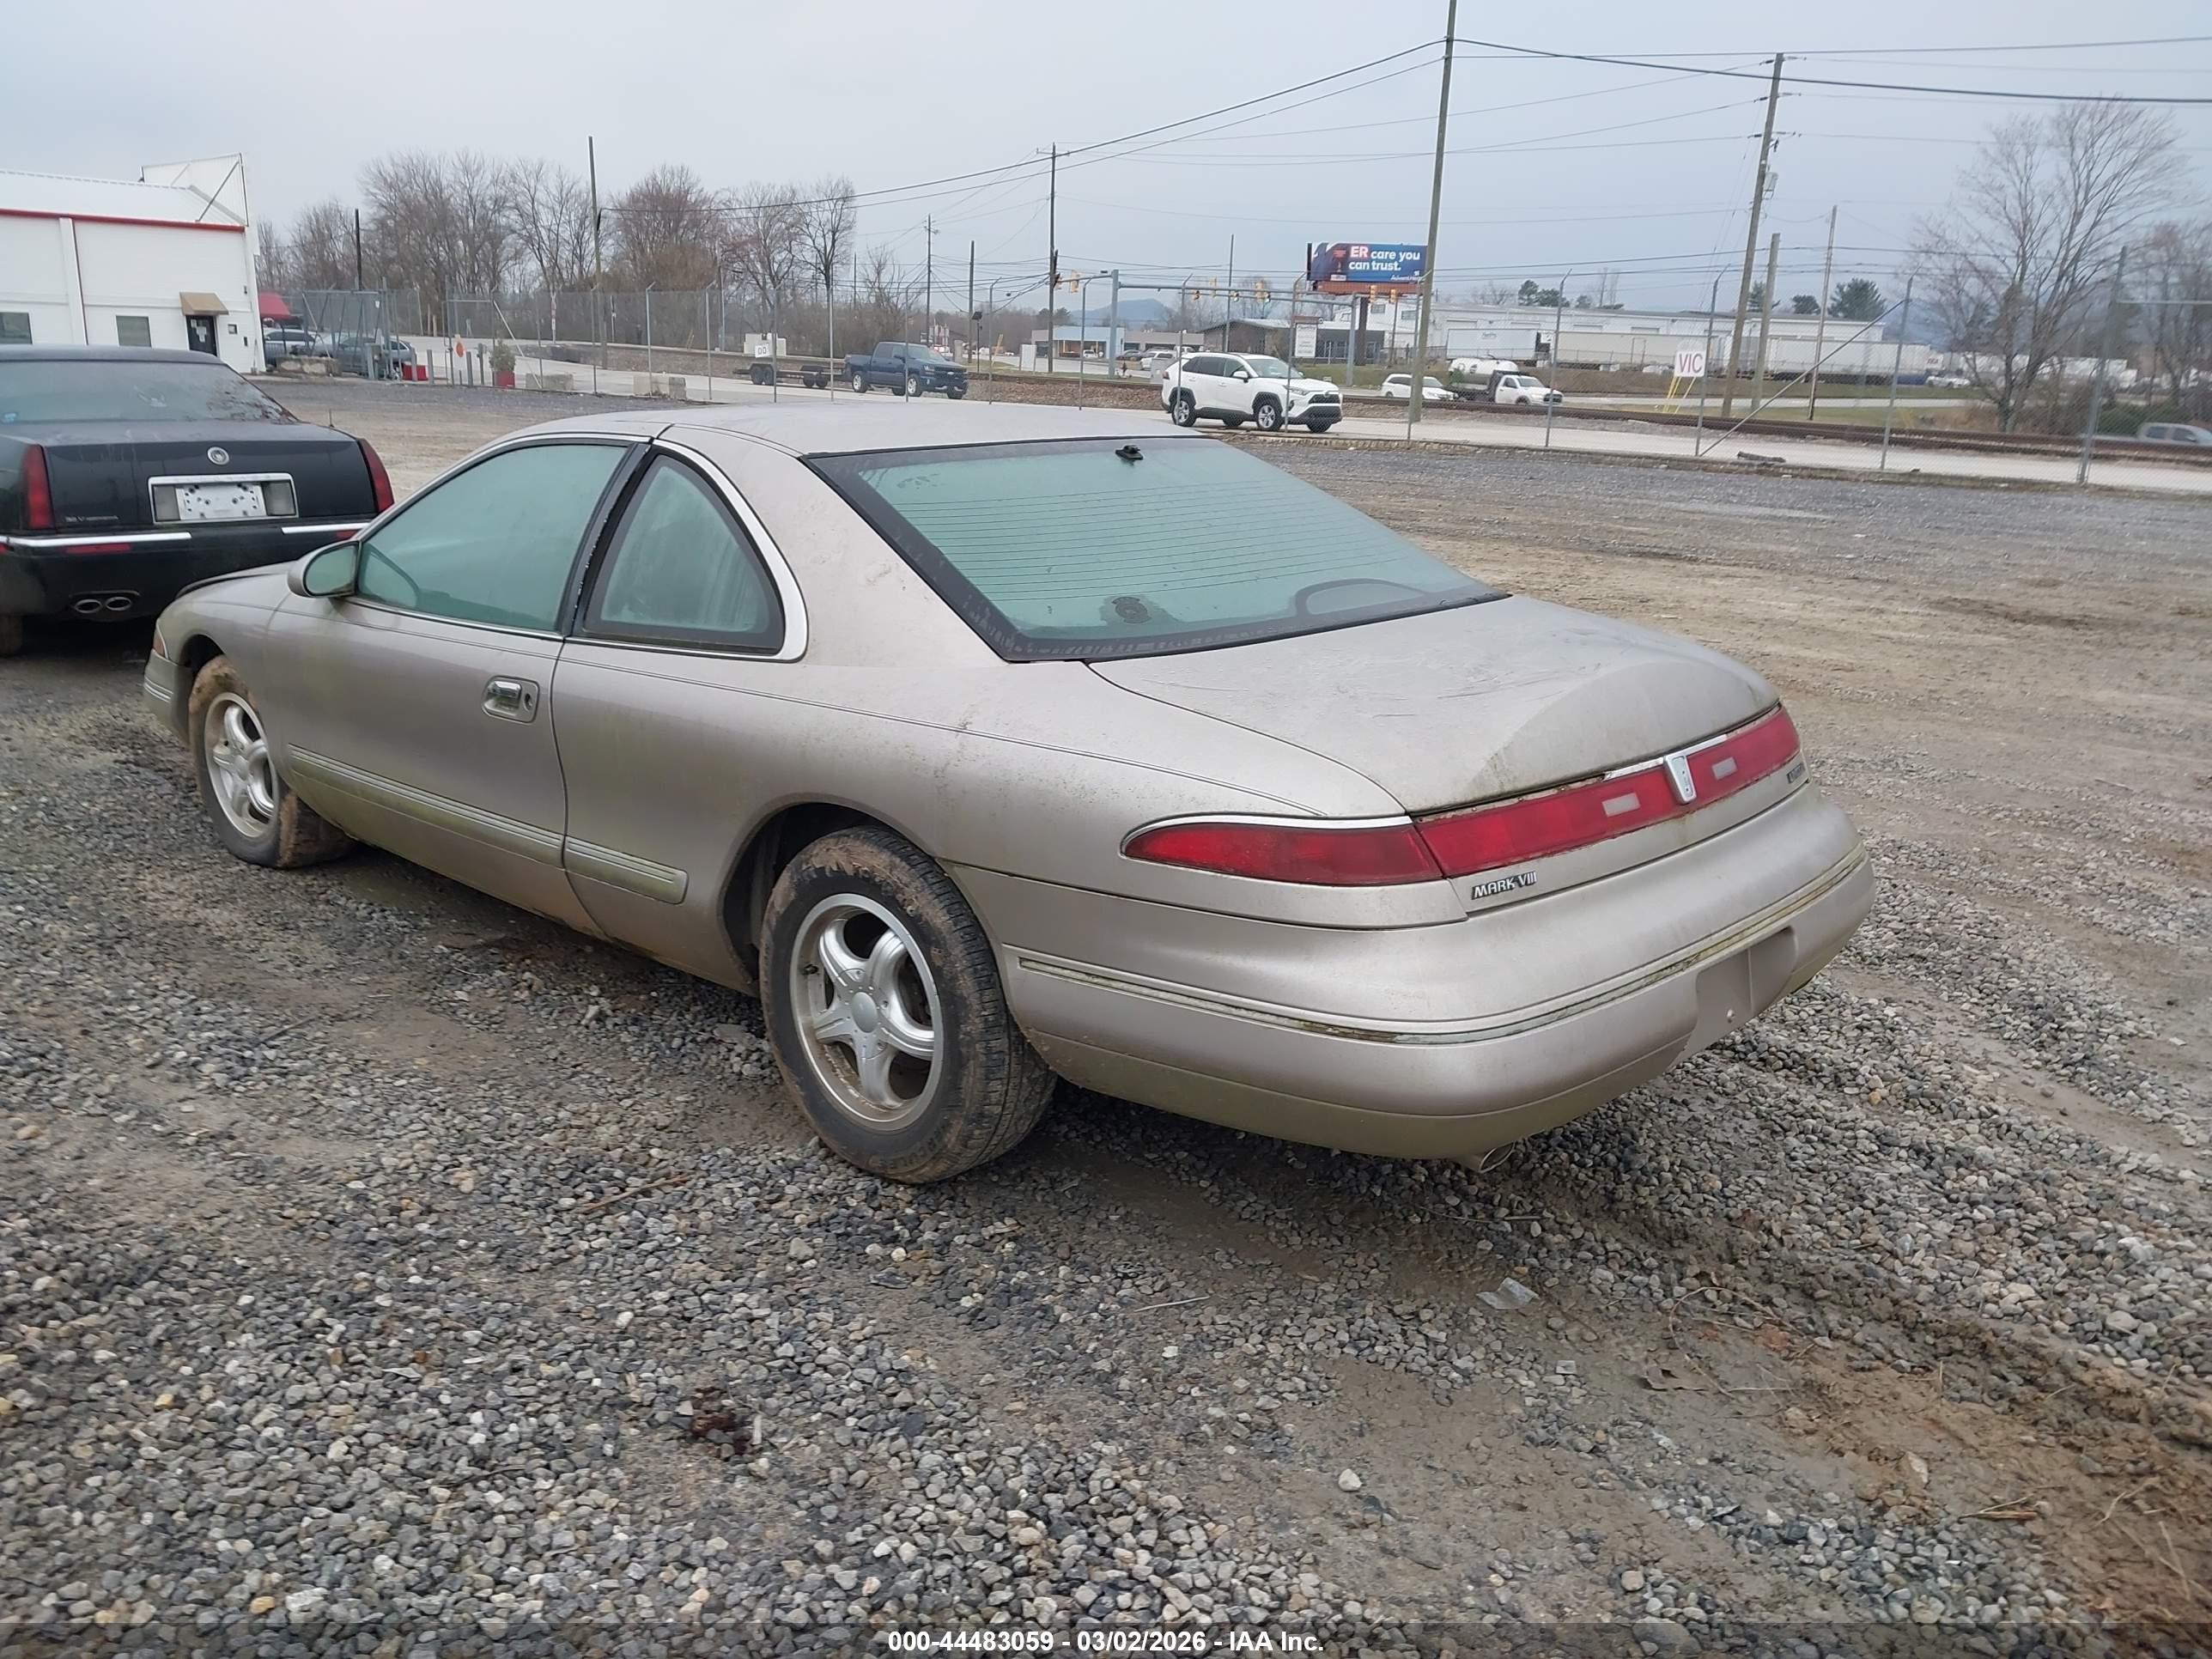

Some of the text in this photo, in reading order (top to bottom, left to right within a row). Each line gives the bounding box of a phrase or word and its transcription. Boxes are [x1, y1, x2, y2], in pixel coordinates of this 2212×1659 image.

[1350, 246, 1421, 263] ER care you
[1348, 260, 1401, 271] can trust.
[1679, 353, 1703, 374] VIC
[1472, 871, 1538, 900] MARK VIII
